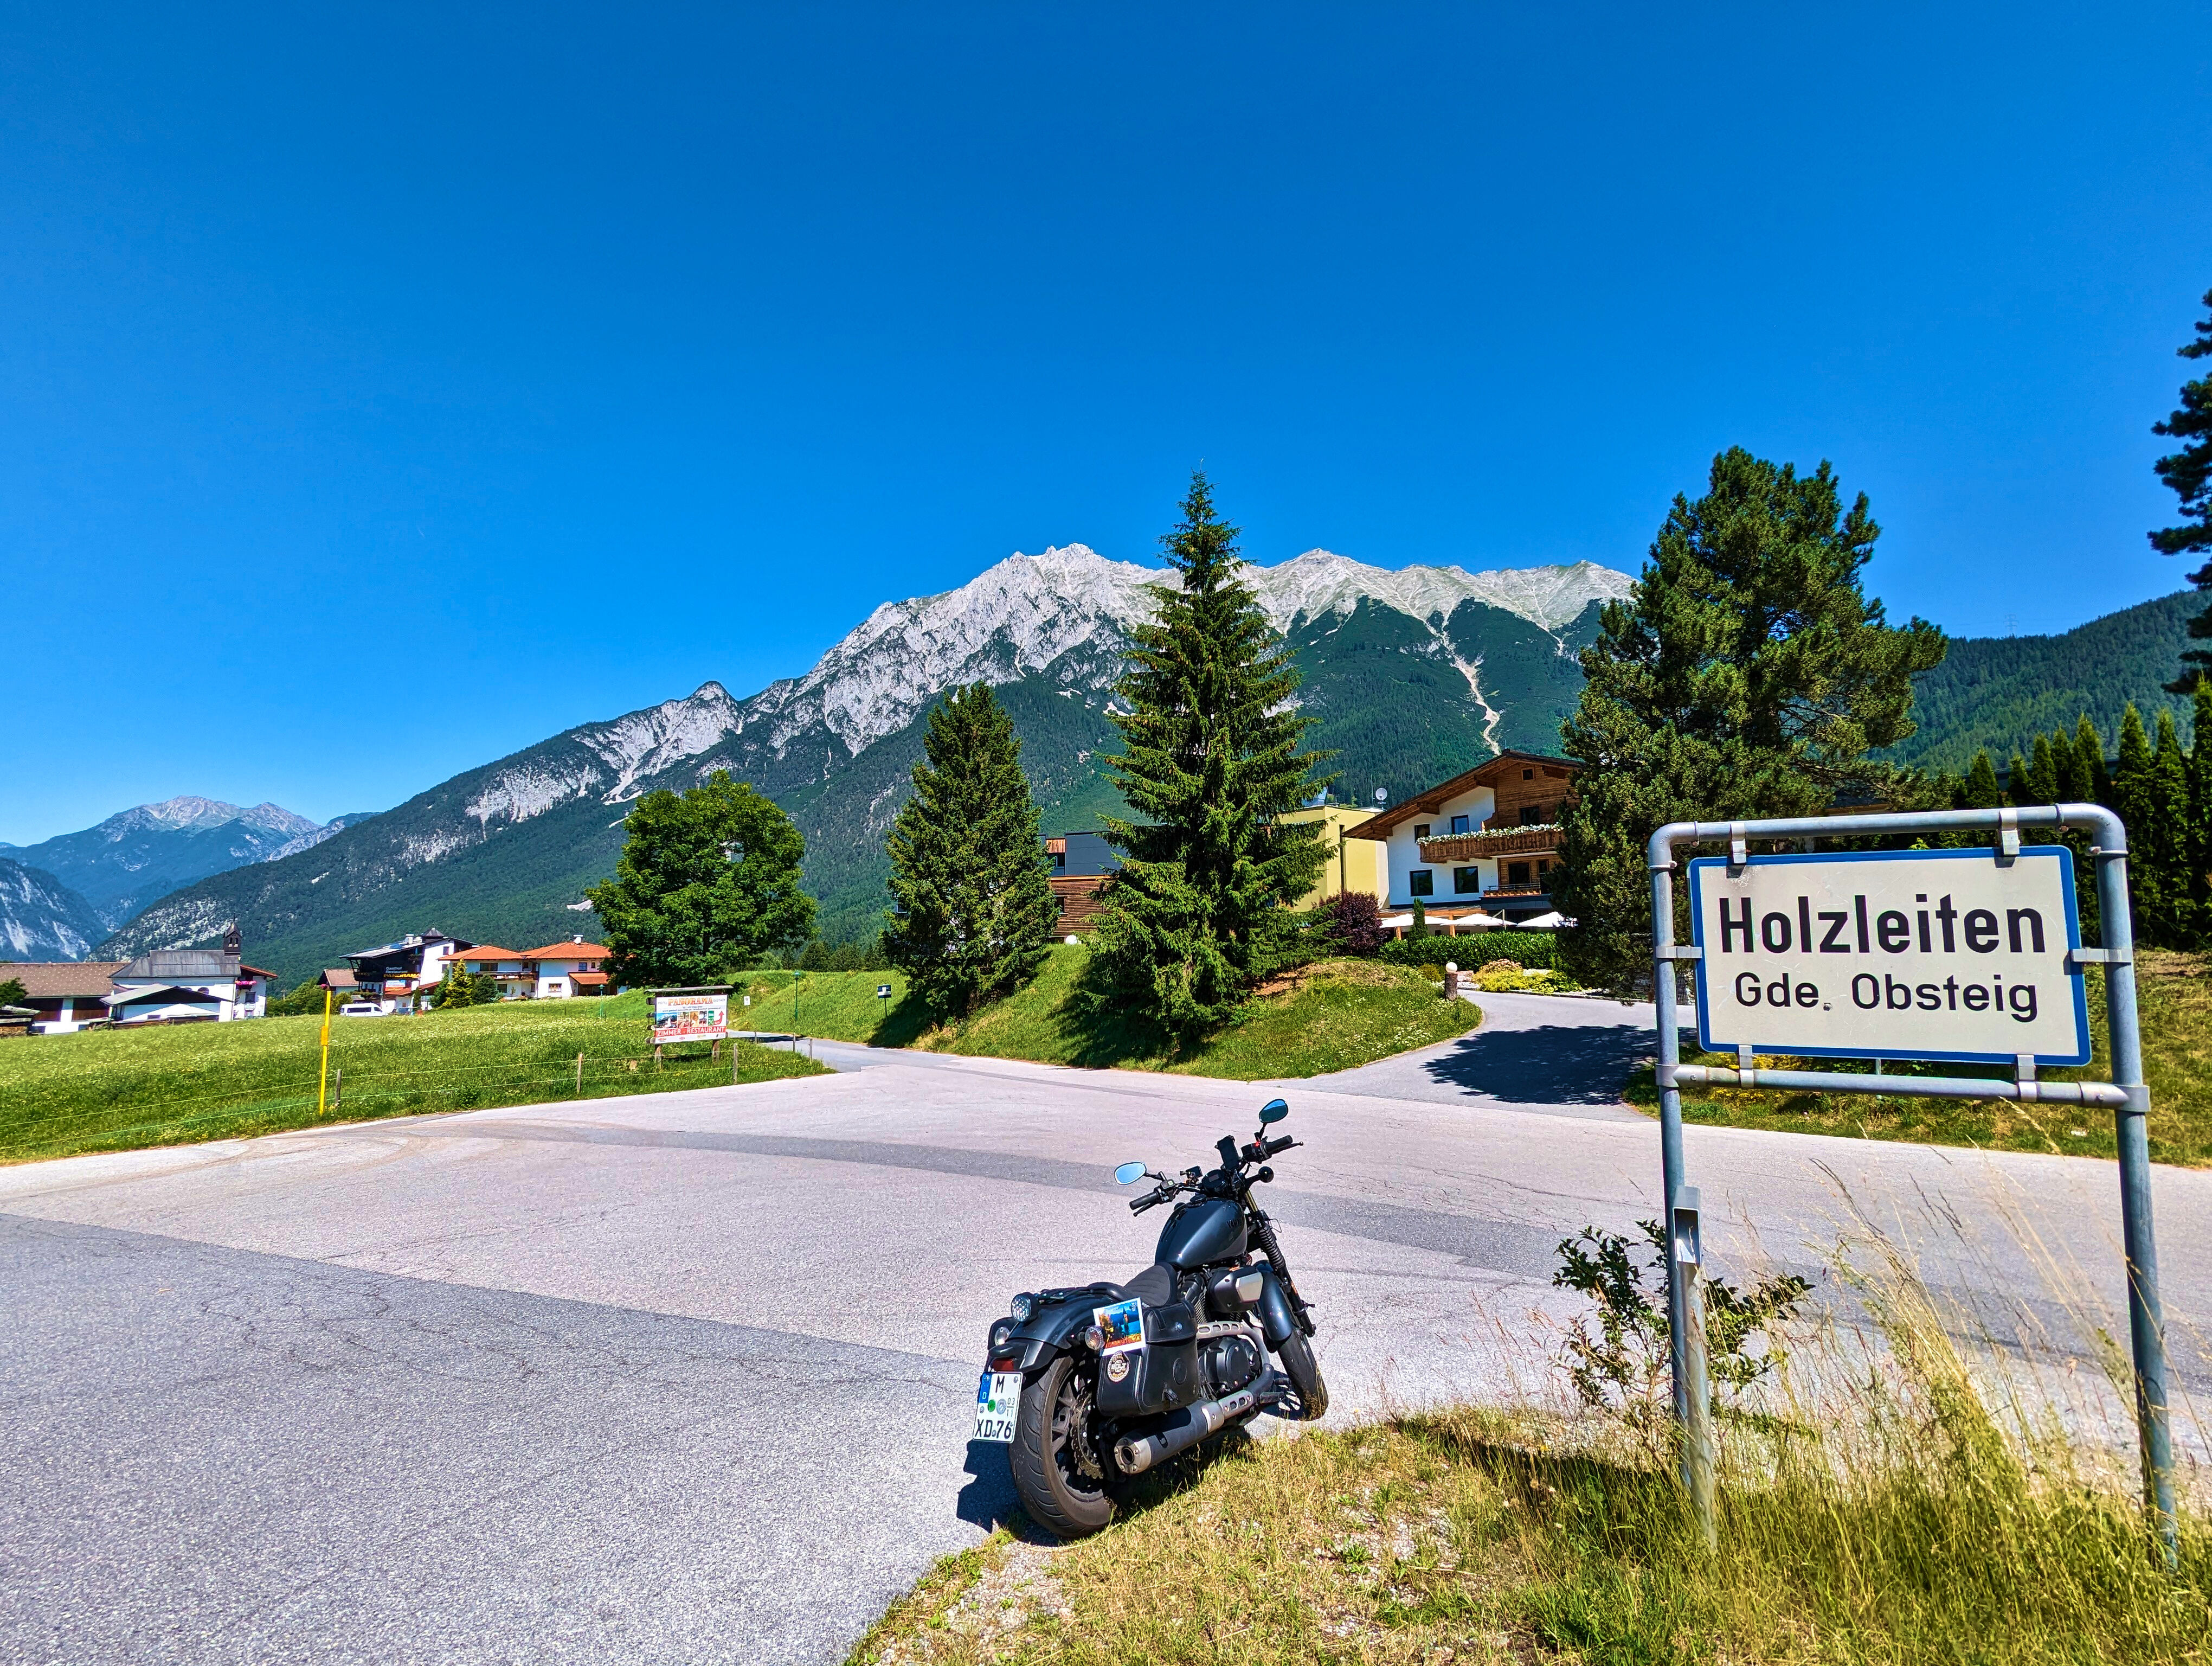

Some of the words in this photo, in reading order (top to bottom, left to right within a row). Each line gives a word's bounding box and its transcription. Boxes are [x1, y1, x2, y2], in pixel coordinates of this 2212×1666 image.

[1720, 894, 2046, 953] Holzleiten
[668, 997, 713, 1006] PANORAMA
[1852, 973, 2037, 1023] Obsteig
[657, 1029, 681, 1037] ZIMMER
[995, 1375, 1005, 1393] M
